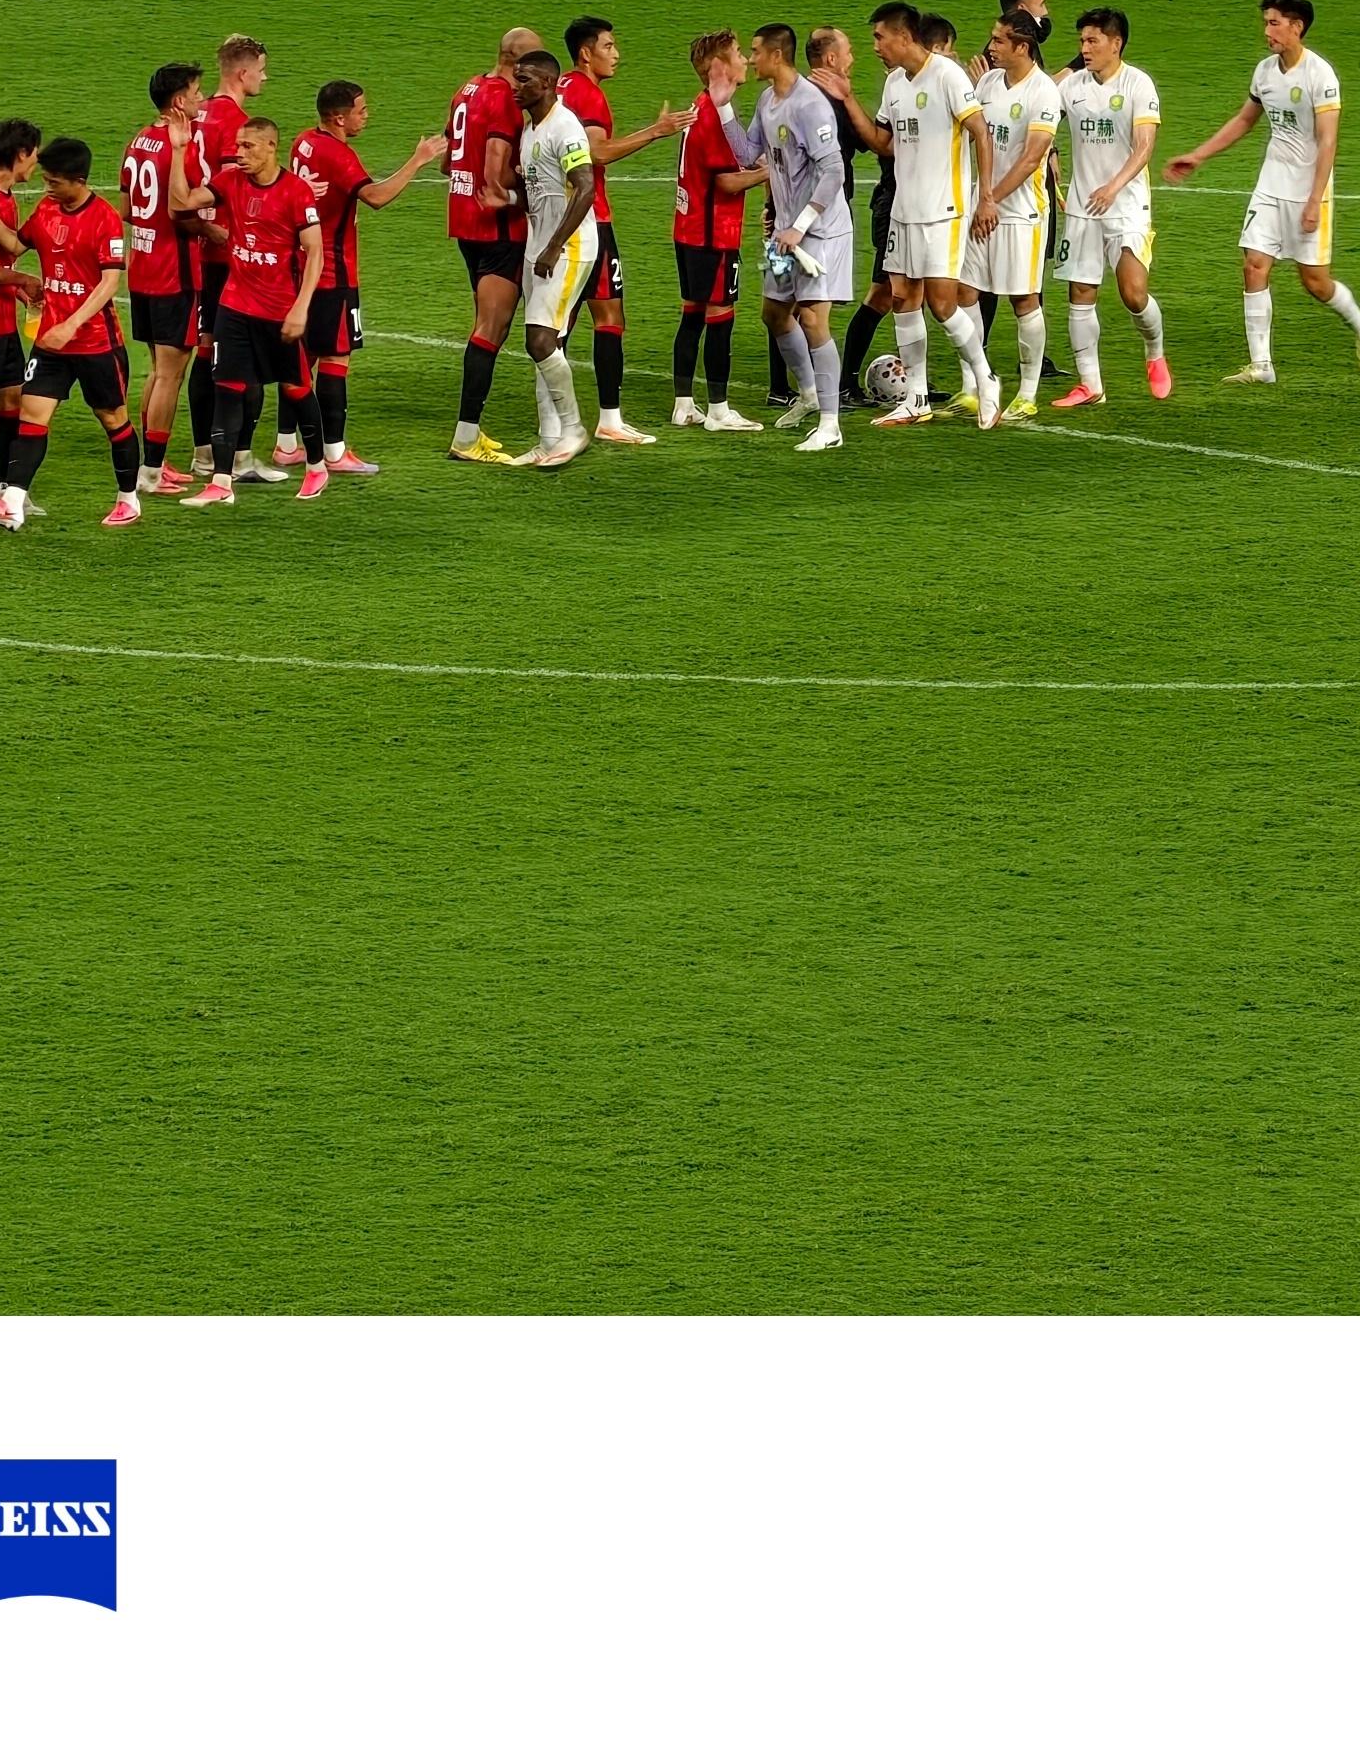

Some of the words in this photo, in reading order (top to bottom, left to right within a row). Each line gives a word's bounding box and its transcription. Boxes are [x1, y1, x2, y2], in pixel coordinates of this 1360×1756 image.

[452, 103, 467, 161] 9
[1080, 117, 1114, 137] 中赫
[123, 158, 159, 219] 29
[1244, 209, 1257, 231] 7
[1059, 239, 1071, 263] 8
[24, 358, 38, 382] 8
